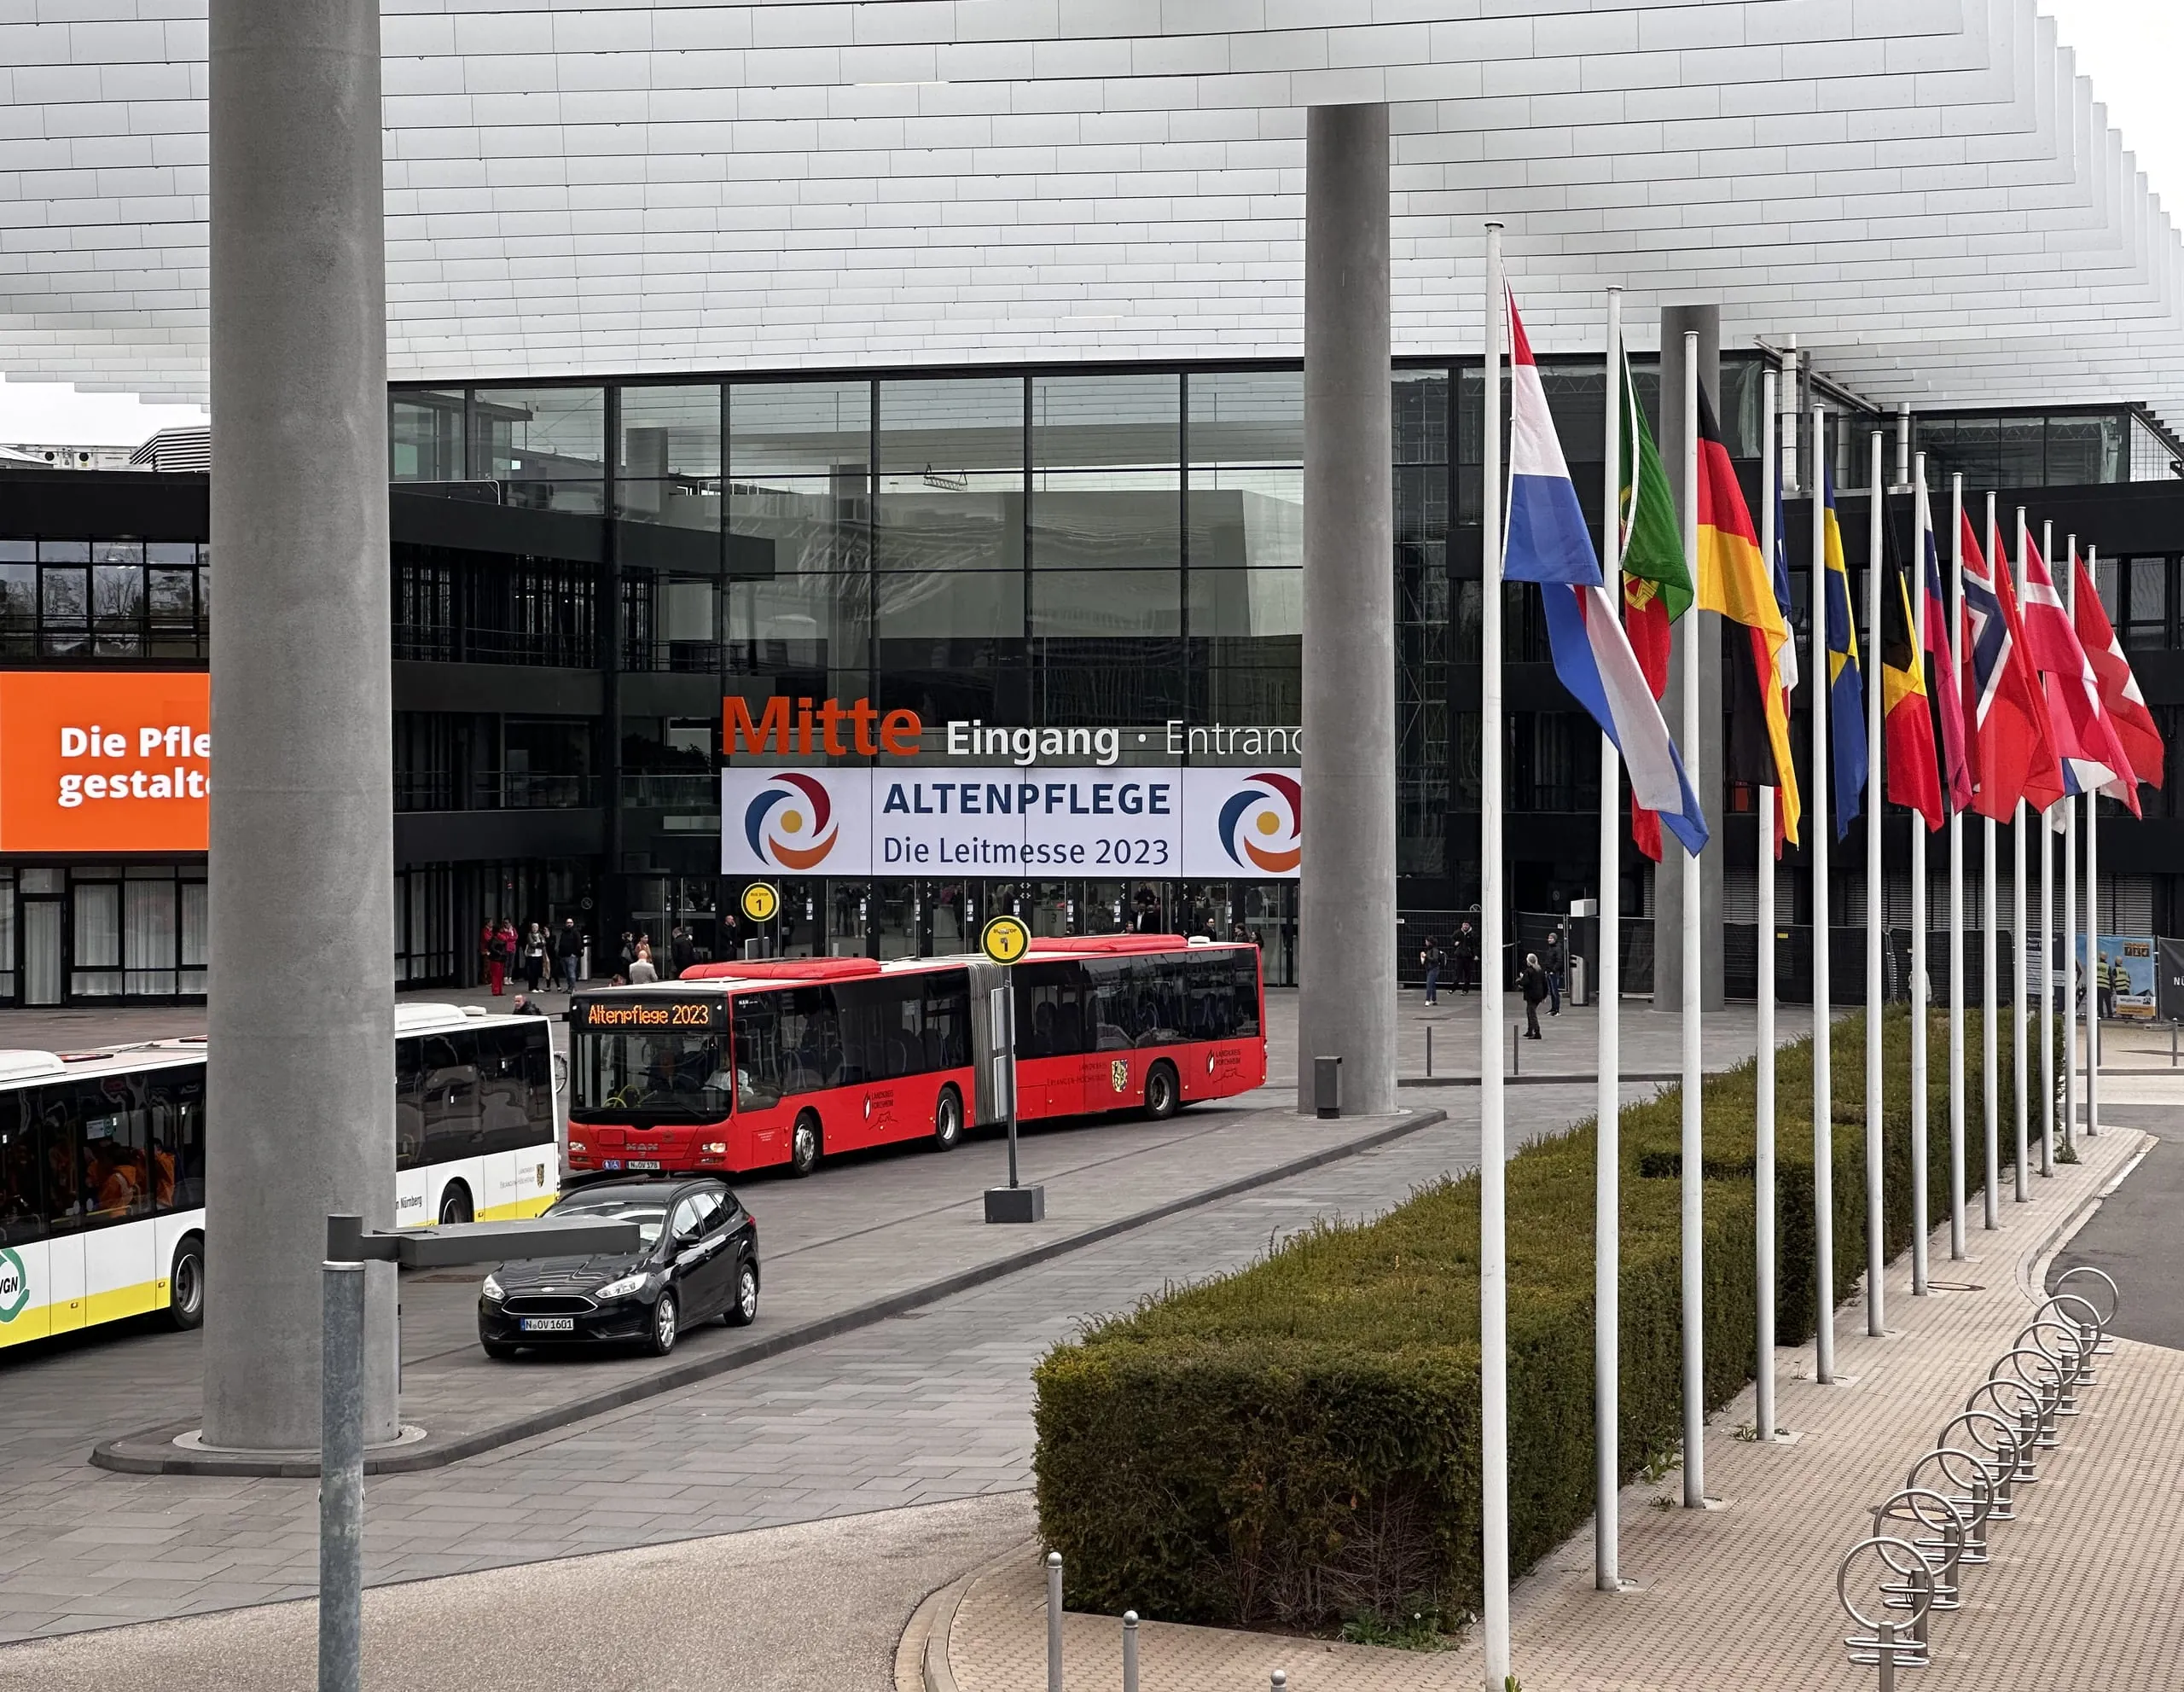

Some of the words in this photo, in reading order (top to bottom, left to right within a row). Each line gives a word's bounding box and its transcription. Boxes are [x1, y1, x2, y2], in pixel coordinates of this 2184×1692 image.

[61, 725, 127, 758] Die
[139, 725, 211, 758] Pfle
[723, 696, 921, 756] Mitte
[947, 719, 1121, 765] Eingang
[57, 766, 211, 808] gestalt
[883, 783, 1170, 814] ALTENPFLEGE
[884, 836, 929, 863] Die
[940, 836, 1085, 863] Leitmesse
[1095, 839, 1169, 865] 2023
[756, 898, 762, 911] 1
[1000, 937, 1008, 952] 1
[588, 1004, 669, 1025] Altenpflege
[671, 1004, 709, 1025] 2023
[551, 1320, 573, 1329] 1601
